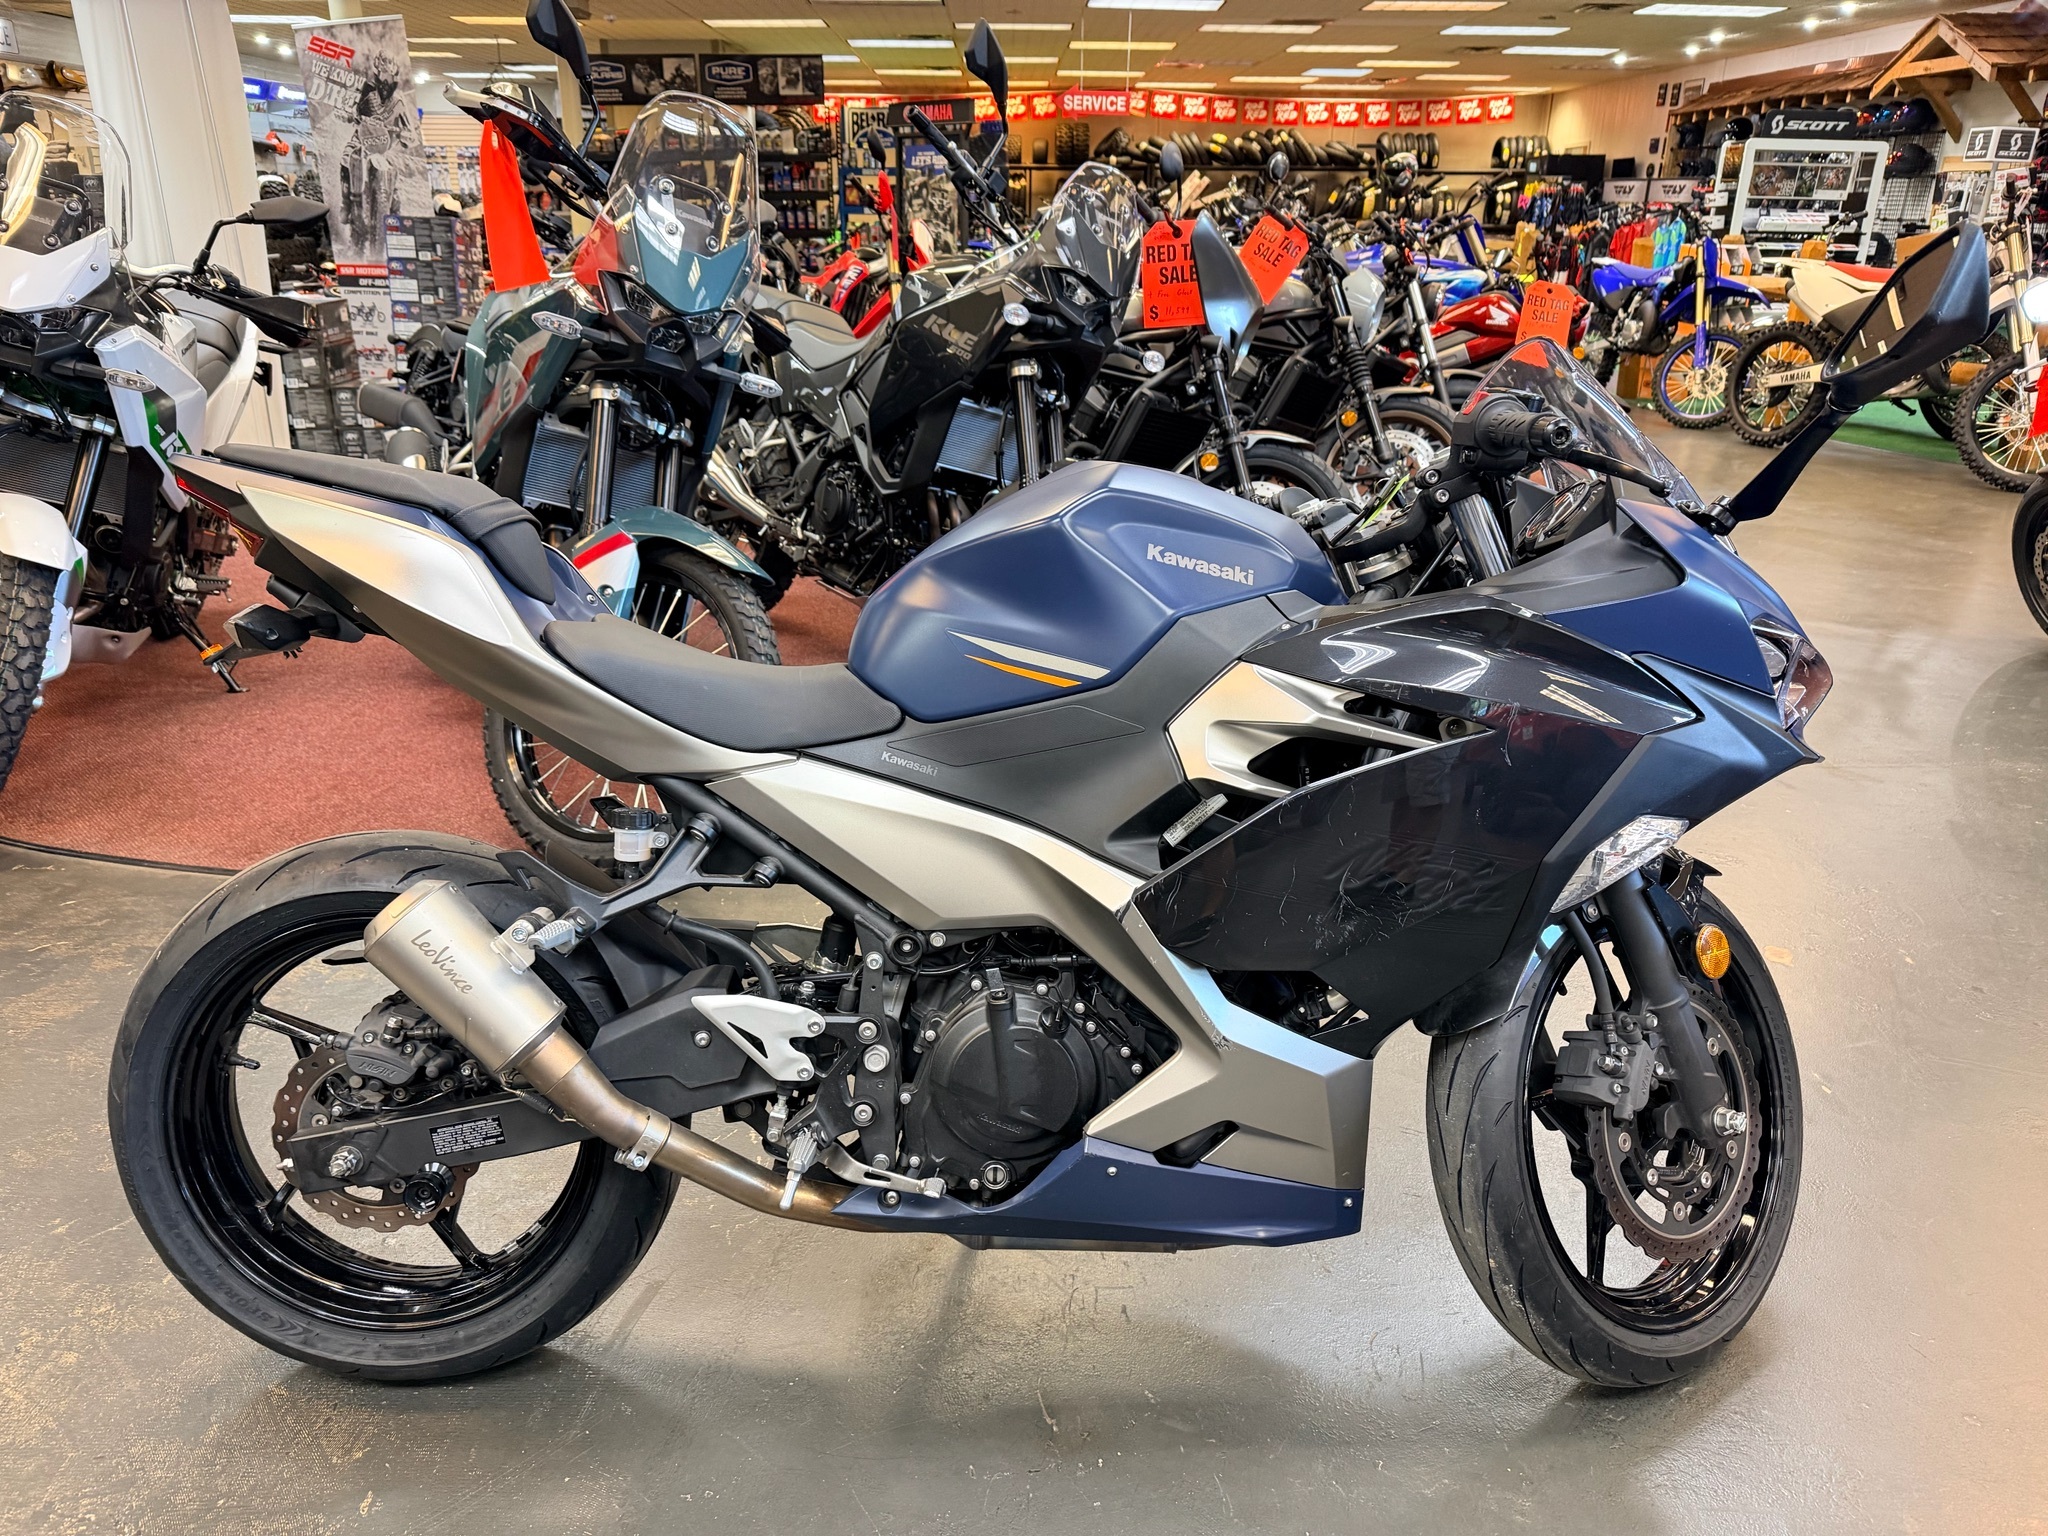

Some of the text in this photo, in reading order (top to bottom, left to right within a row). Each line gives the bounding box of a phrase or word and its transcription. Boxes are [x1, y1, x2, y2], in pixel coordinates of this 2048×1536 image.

[307, 35, 355, 69] SSR
[312, 60, 366, 90] WE KNOW
[711, 66, 746, 75] PURE
[308, 77, 361, 115] DIRT
[1063, 94, 1127, 112] SERVICE
[919, 104, 953, 120] AMAHA
[1784, 120, 1849, 131] SCOTT
[1614, 185, 1635, 195] FLY
[1662, 184, 1686, 195] FLY
[1256, 225, 1302, 258] RED TAG
[1146, 244, 1177, 264] RED
[1253, 242, 1284, 268] SALE
[1159, 265, 1198, 285] SALE
[1527, 294, 1570, 311] RED TAG
[1150, 304, 1159, 322] $
[1531, 309, 1559, 324] SALE
[923, 313, 979, 352] KLE
[946, 344, 973, 360] 500
[1780, 371, 1811, 383] YAMAHA
[1146, 543, 1255, 586] Kawasaki
[880, 750, 938, 777] Kawasaki
[410, 929, 473, 994] LeoVince
